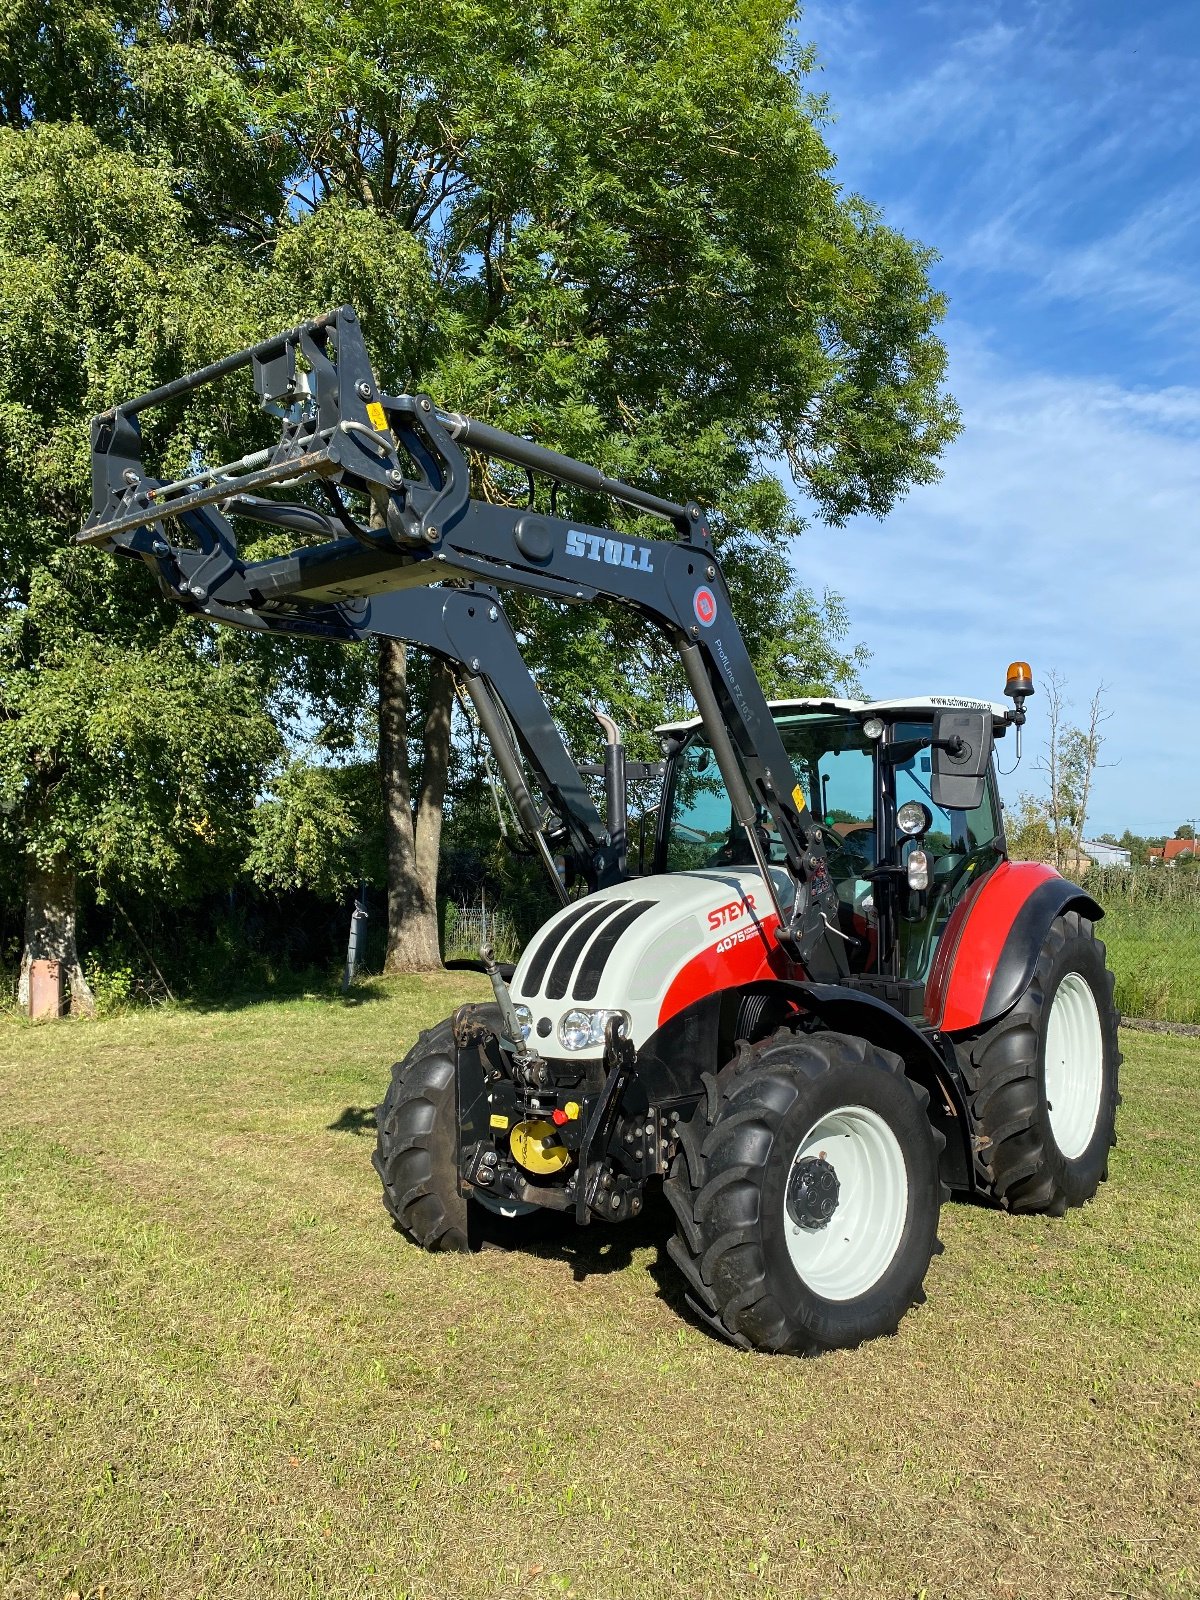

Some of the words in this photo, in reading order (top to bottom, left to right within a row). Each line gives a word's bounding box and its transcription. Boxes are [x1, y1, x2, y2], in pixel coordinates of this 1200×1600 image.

[565, 529, 654, 573] STOLL
[714, 638, 735, 684] ProfiLine
[733, 684, 744, 699] FZ
[707, 894, 757, 932] STEYR
[716, 931, 746, 954] 4075
